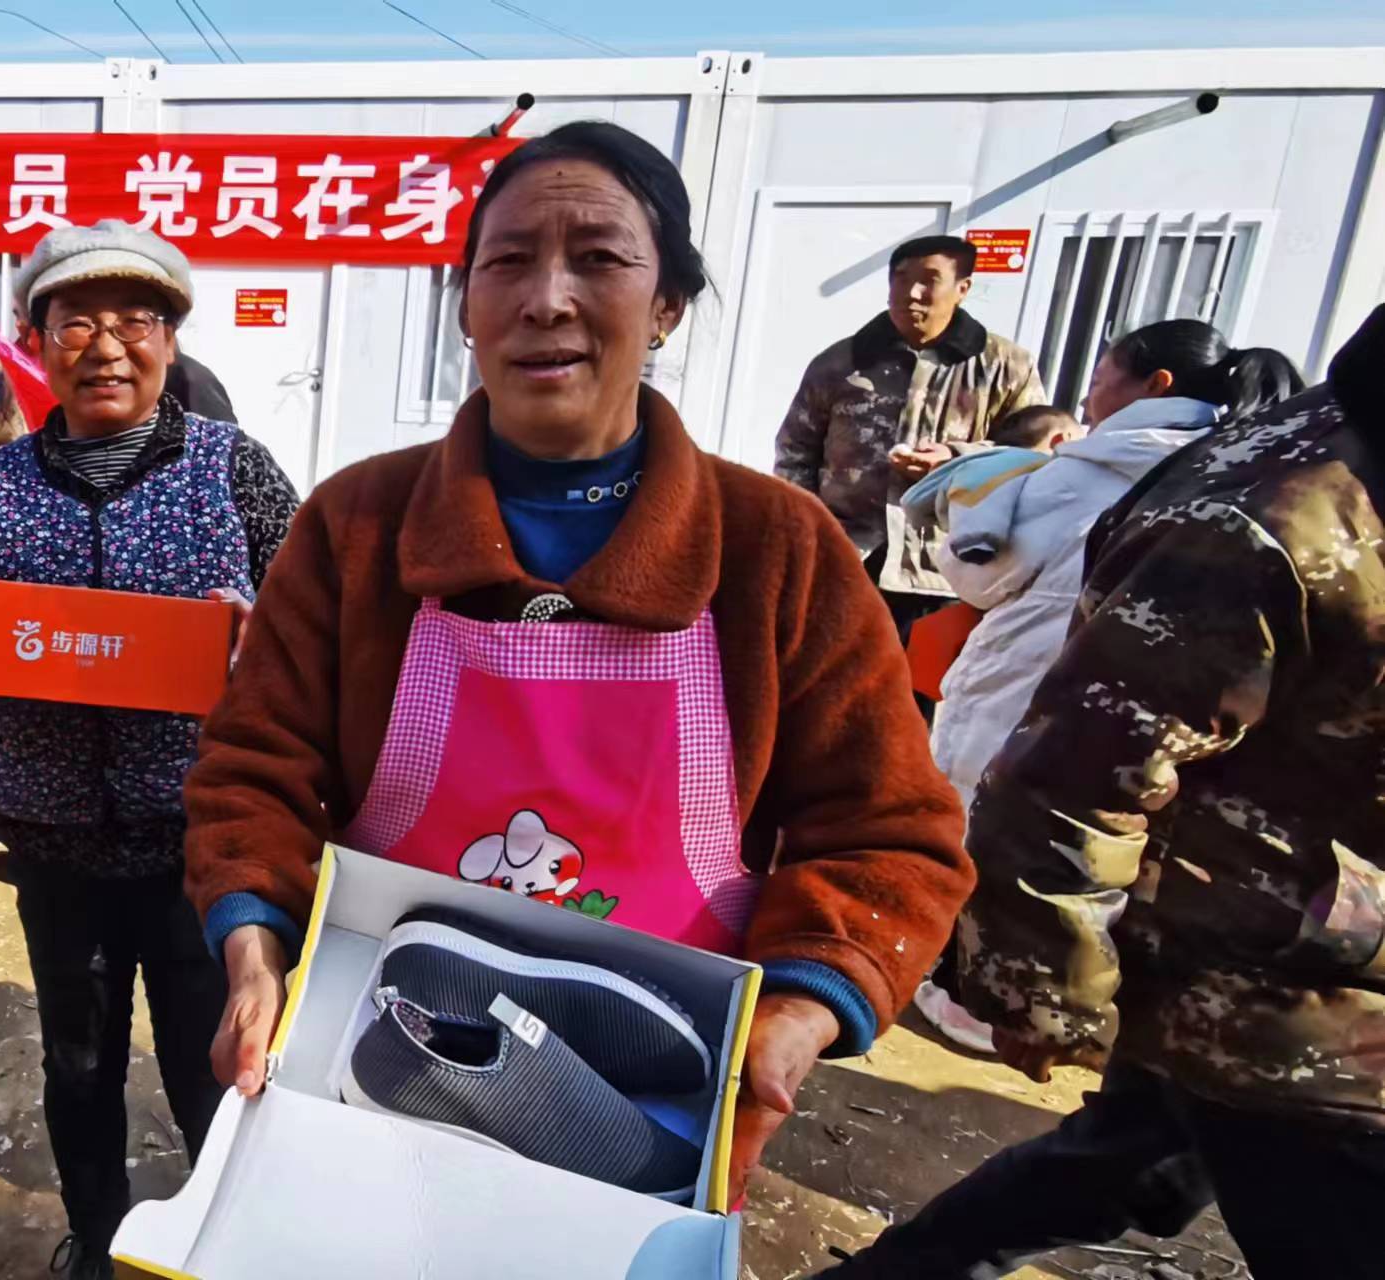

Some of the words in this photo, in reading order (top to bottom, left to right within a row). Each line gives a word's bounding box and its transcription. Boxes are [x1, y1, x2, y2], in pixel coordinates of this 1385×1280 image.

[124, 152, 498, 244] 党员在身
[51, 630, 124, 658] 步源轩
